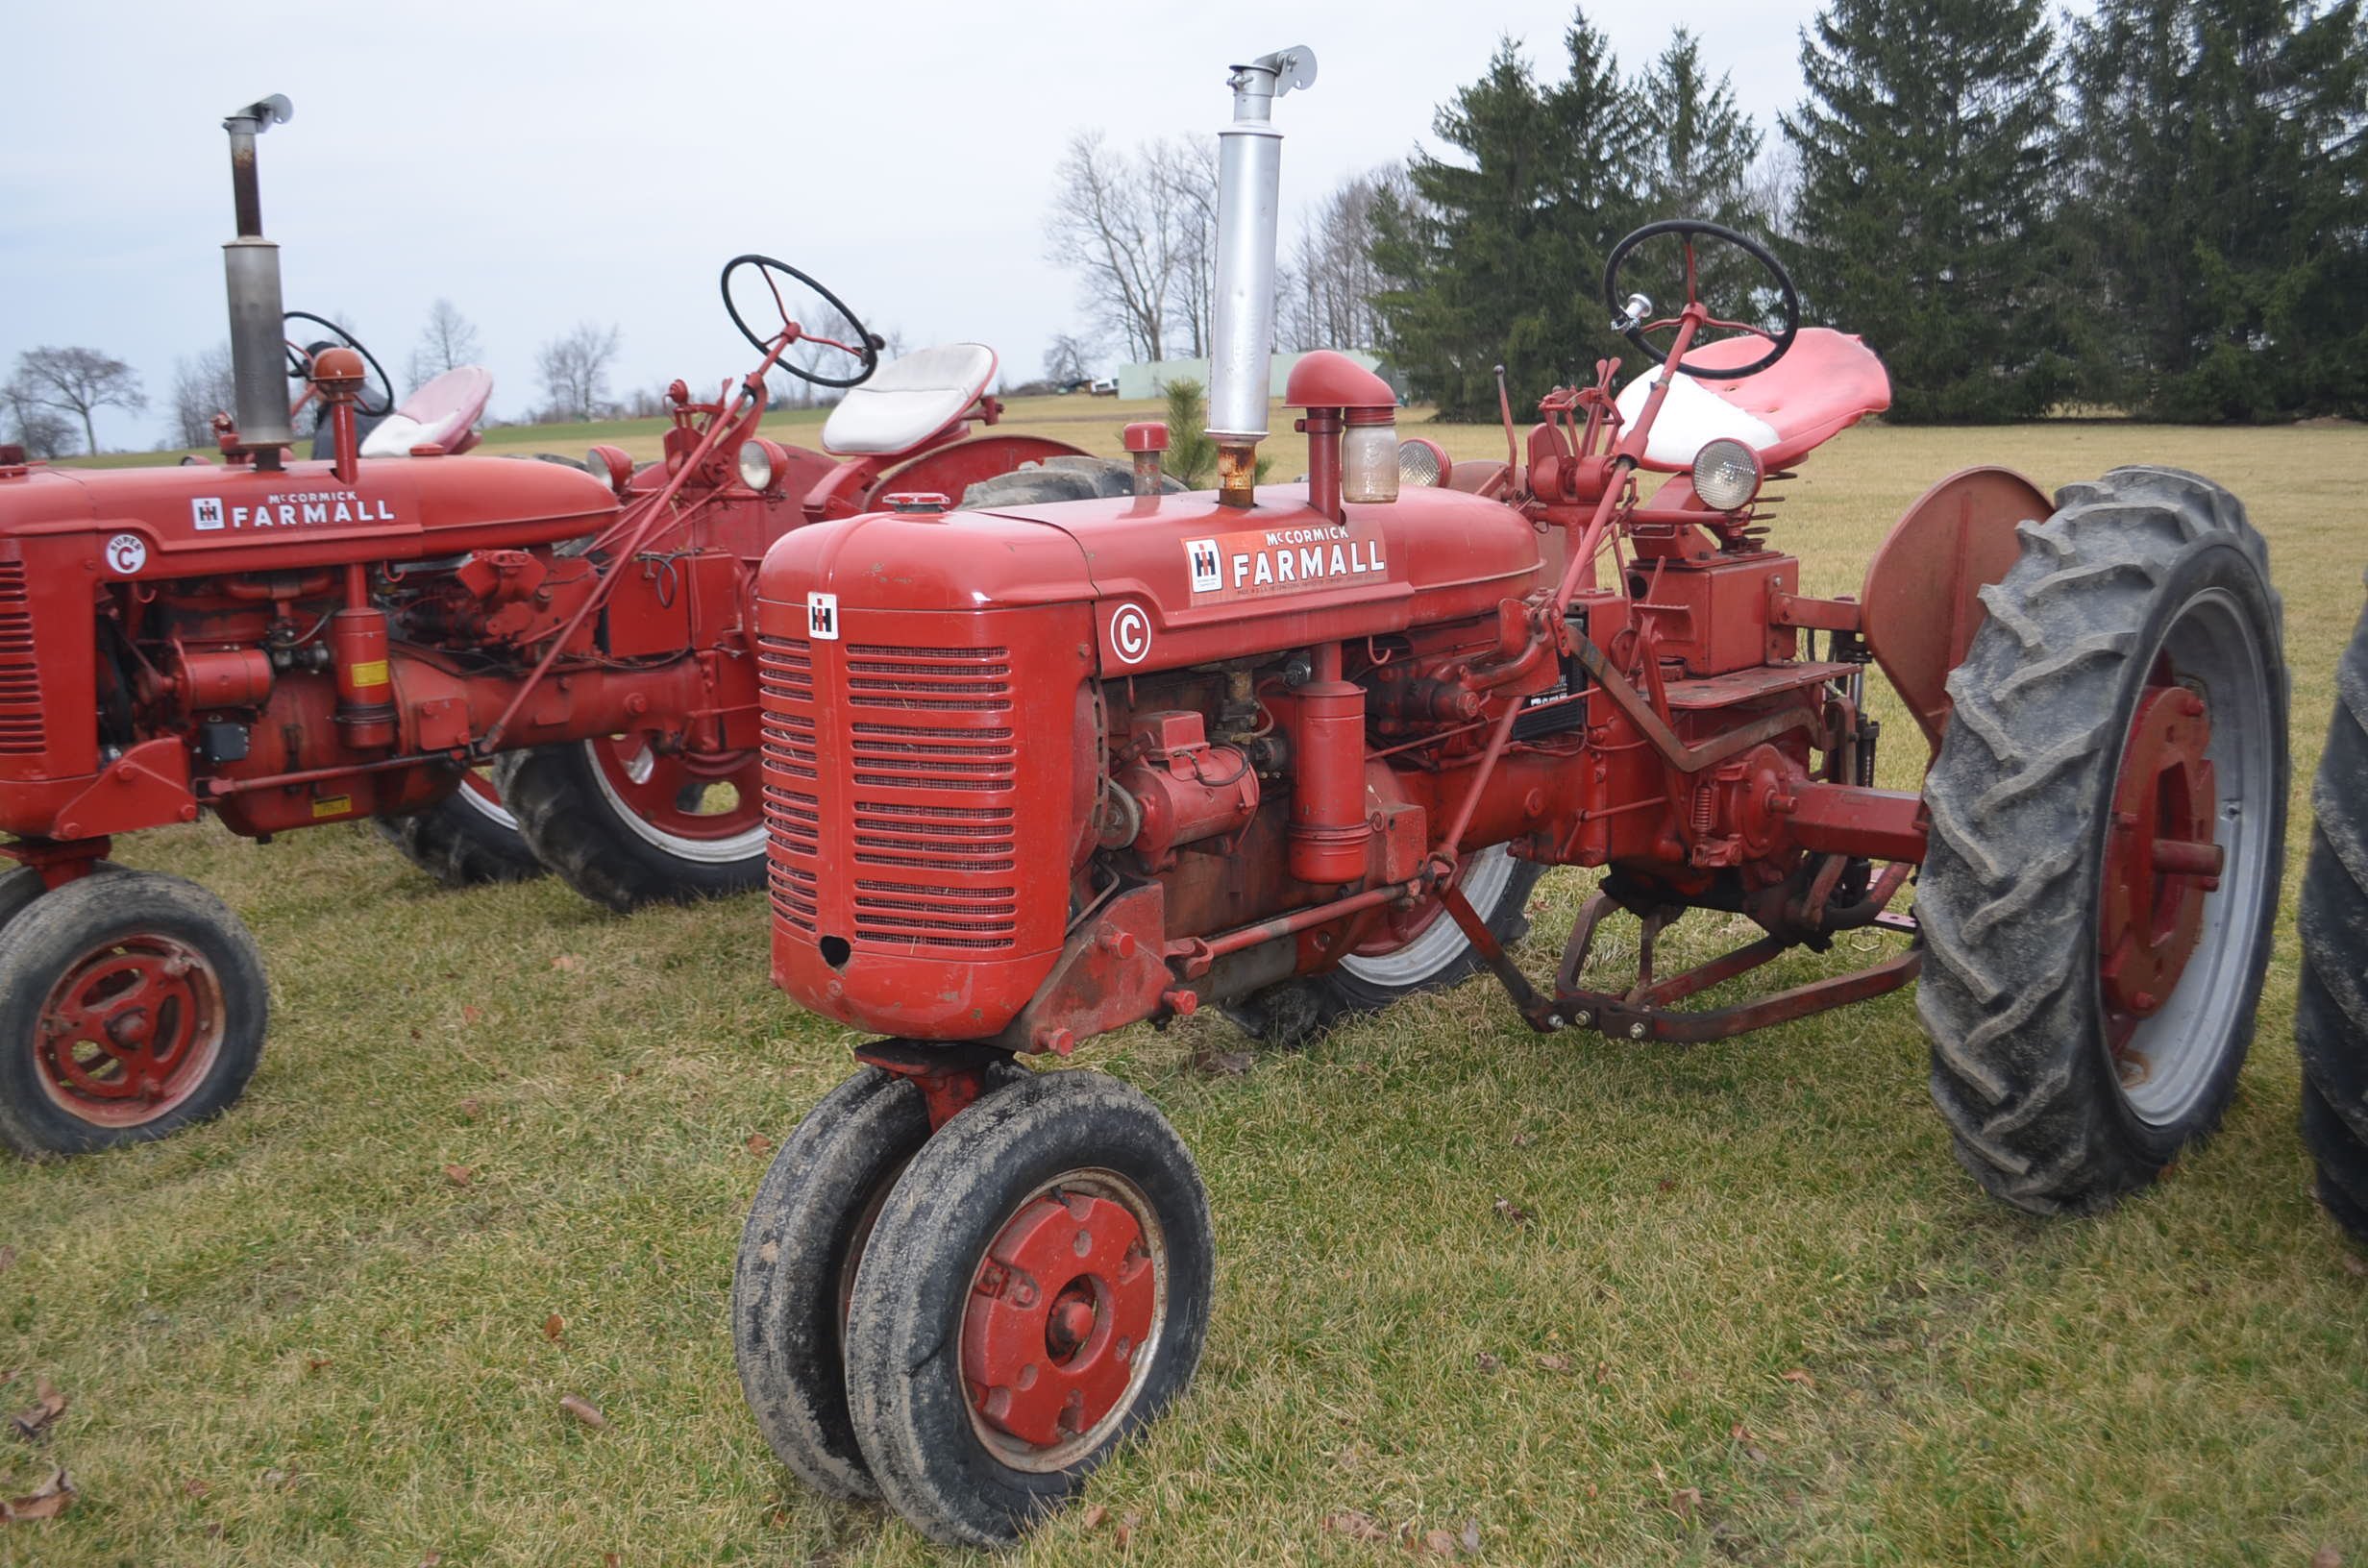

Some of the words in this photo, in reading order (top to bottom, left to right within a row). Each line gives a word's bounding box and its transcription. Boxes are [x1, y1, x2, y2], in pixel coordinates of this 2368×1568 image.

[268, 491, 358, 504] McCORMICK
[232, 500, 395, 527] FARMALL
[1265, 526, 1350, 547] McCORMICK
[117, 546, 136, 570] C
[1232, 540, 1385, 589] FARMALL
[1121, 614, 1142, 653] C
